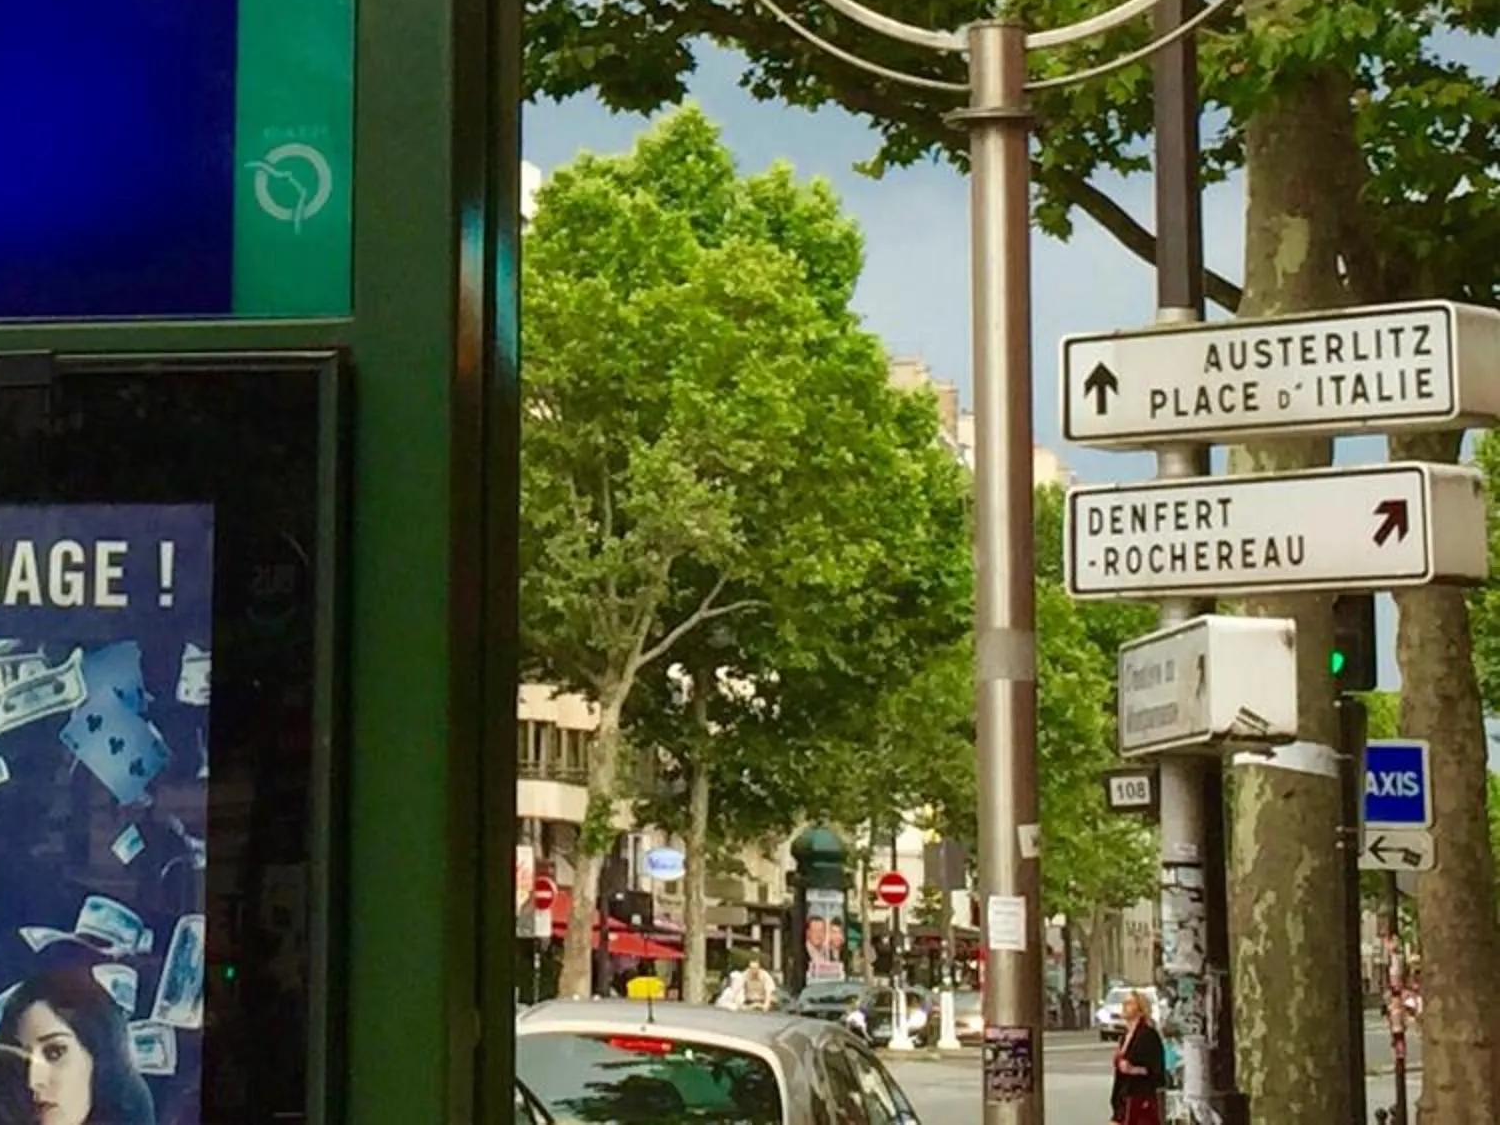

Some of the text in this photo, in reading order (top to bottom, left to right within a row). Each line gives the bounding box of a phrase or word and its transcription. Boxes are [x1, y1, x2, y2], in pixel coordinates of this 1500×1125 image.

[1203, 324, 1433, 374] AUSTERLITZ
[1149, 380, 1260, 420] PLACE
[1088, 496, 1233, 537] DENFERT
[1116, 780, 1147, 800] 108
